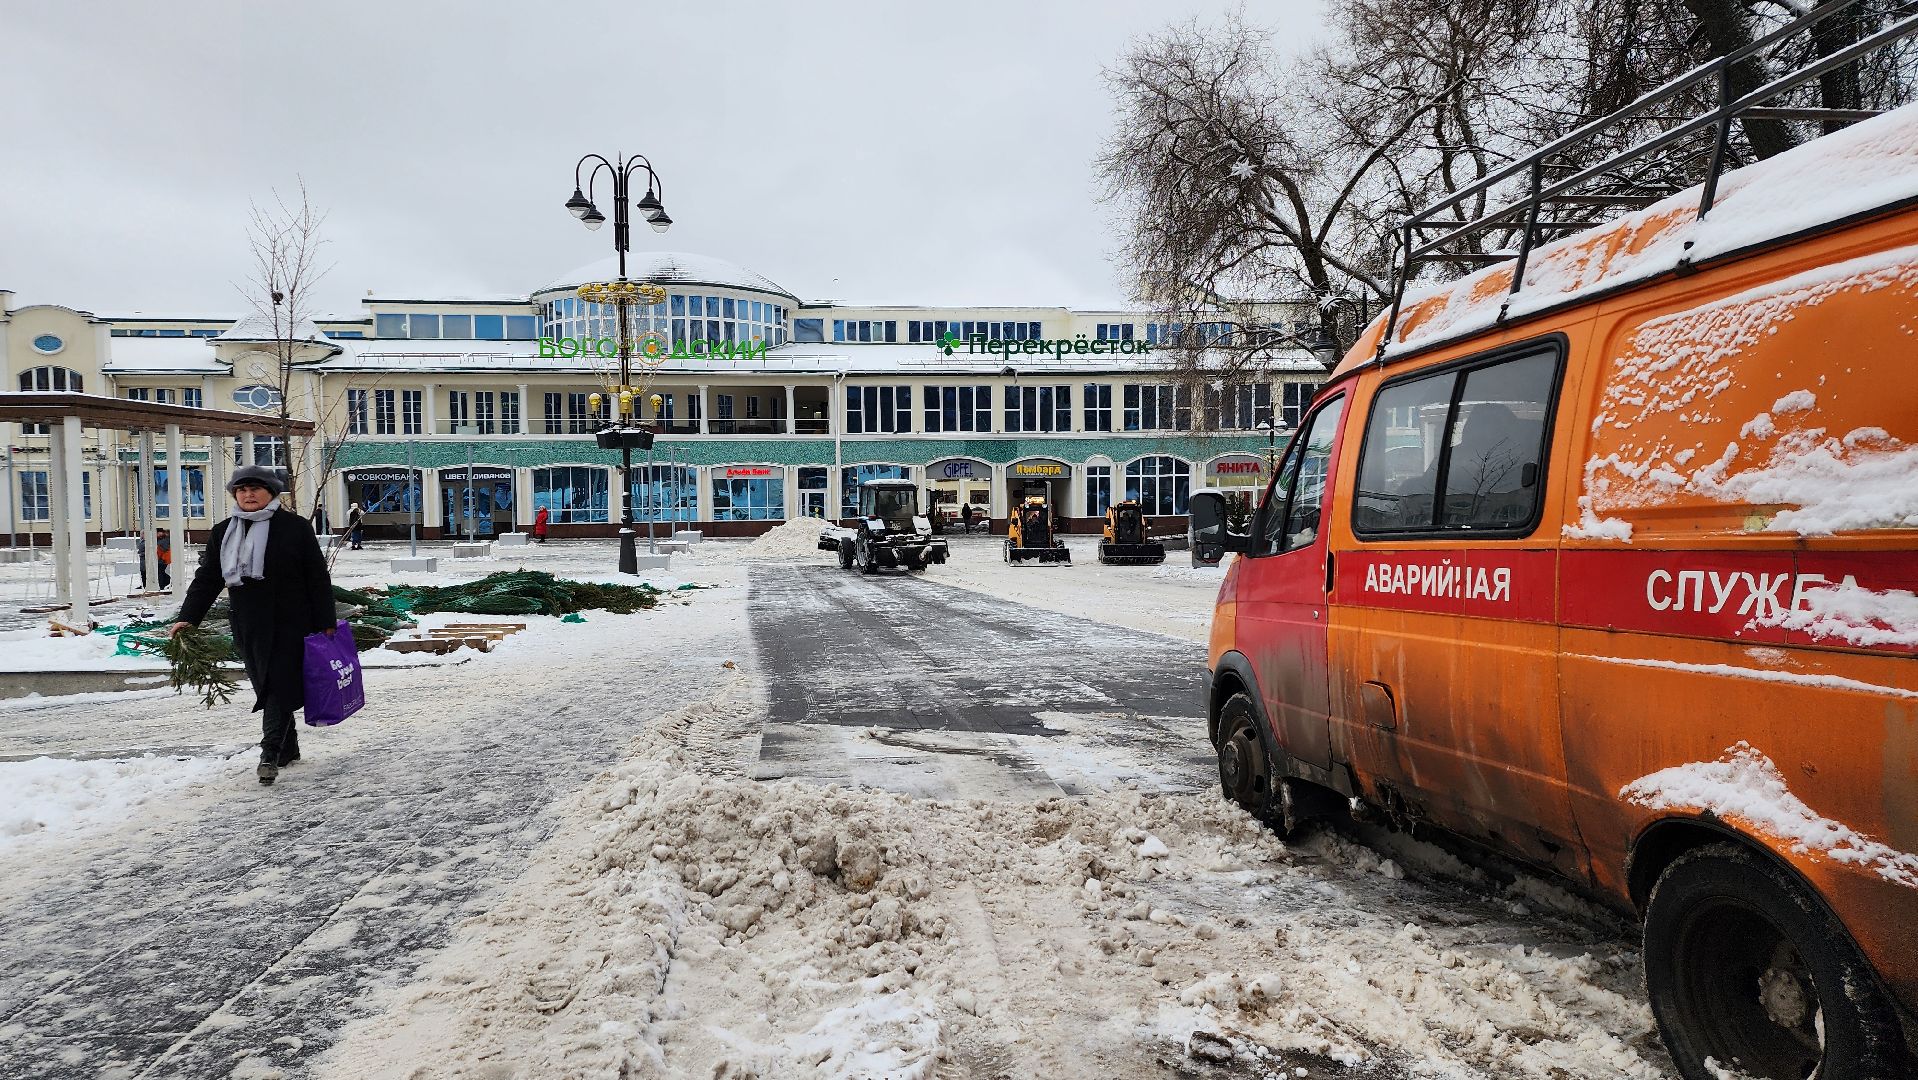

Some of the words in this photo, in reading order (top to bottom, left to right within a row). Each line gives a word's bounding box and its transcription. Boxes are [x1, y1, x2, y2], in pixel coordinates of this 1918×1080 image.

[538, 334, 766, 361] БОГООДСКИЙ
[969, 332, 1151, 361] Перекрёсток
[943, 462, 974, 478] GIPFEL
[1216, 462, 1261, 474] ЯНИТА
